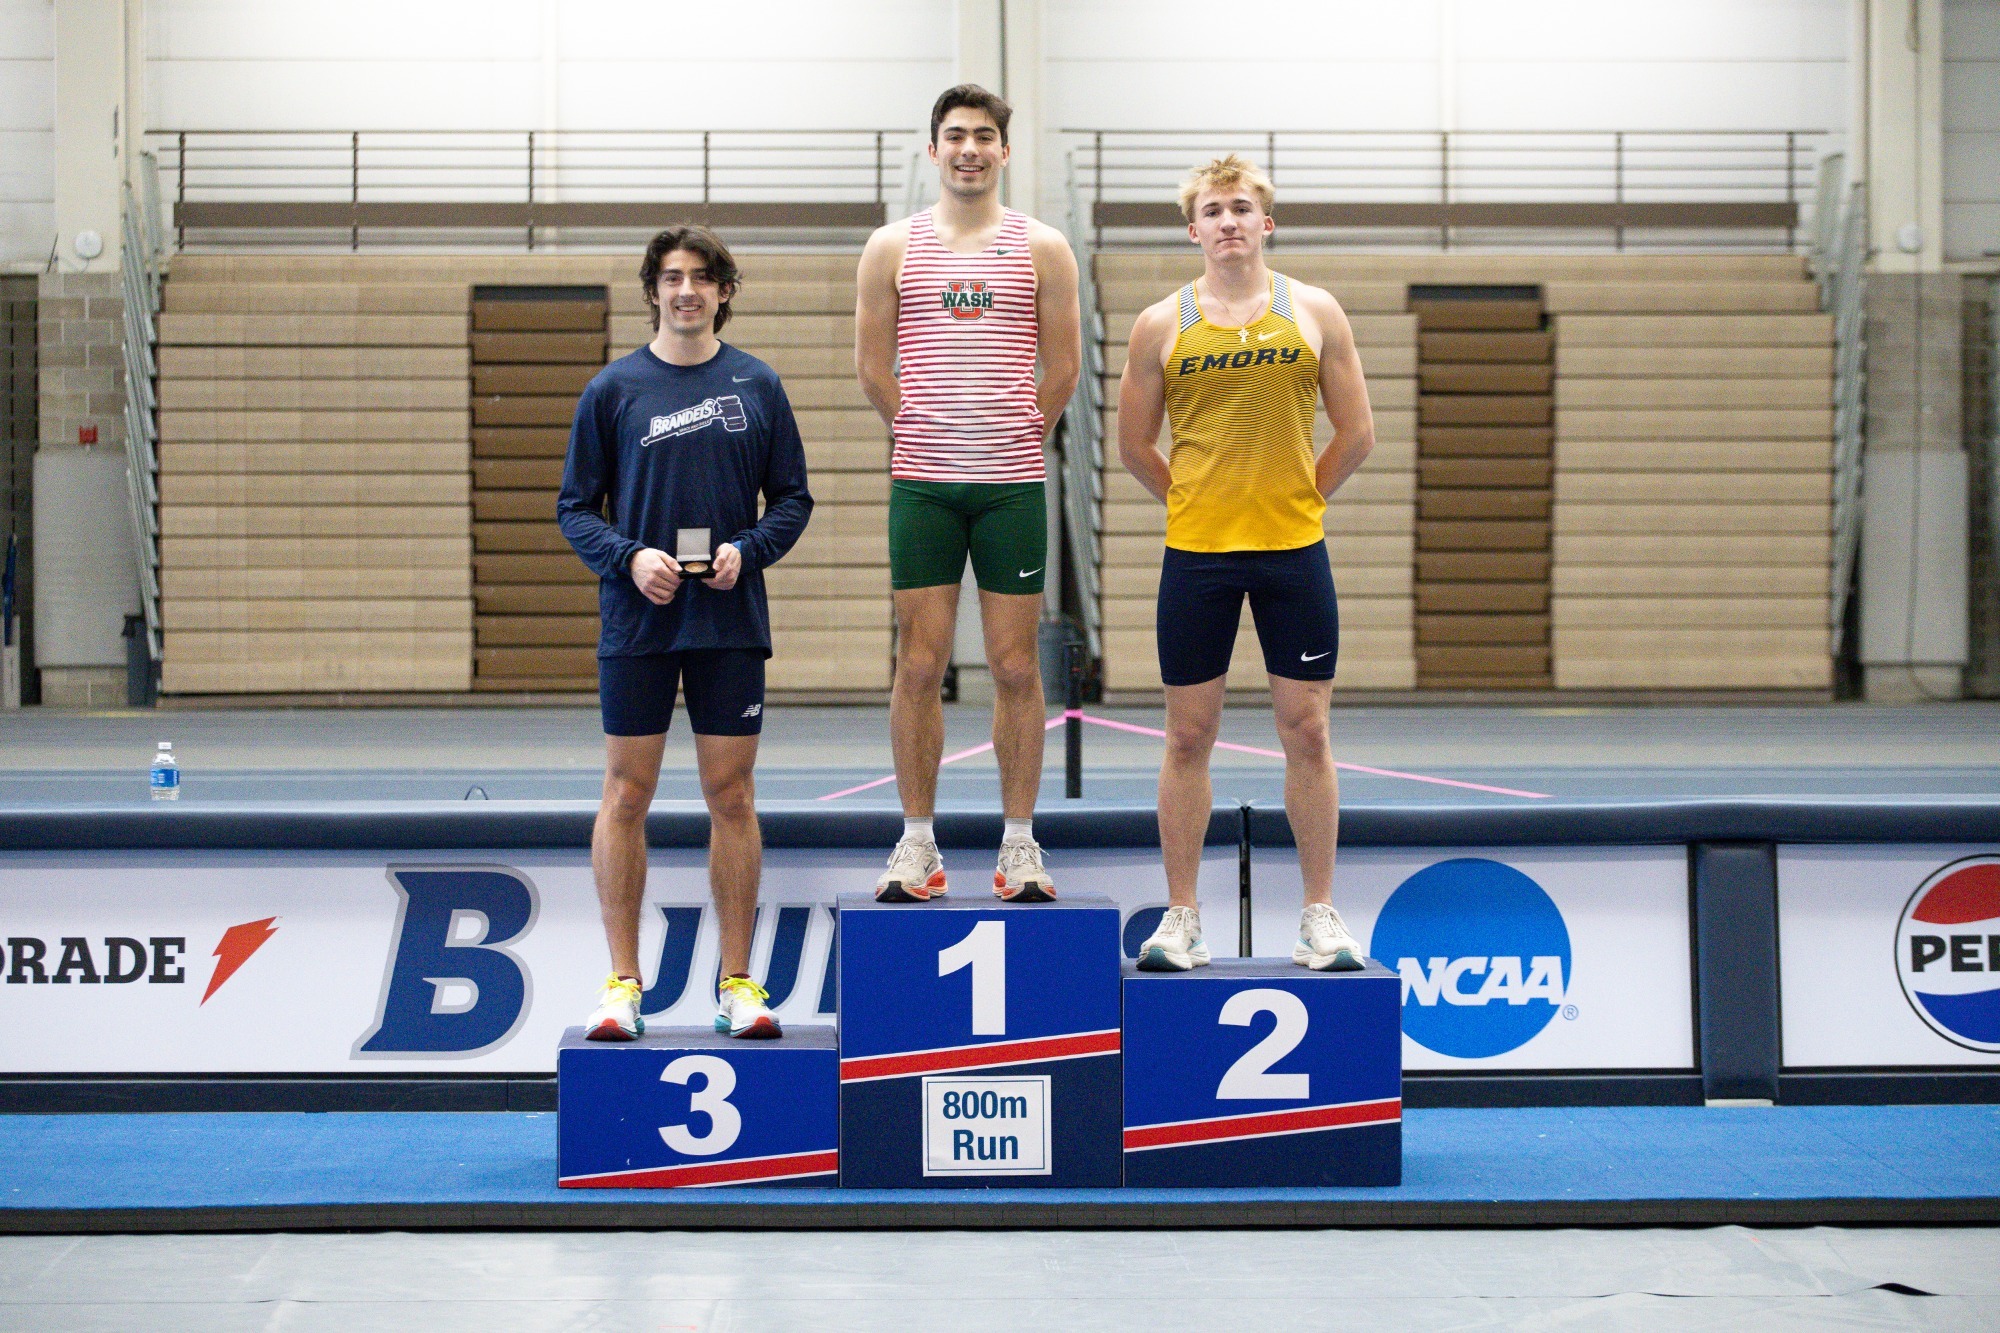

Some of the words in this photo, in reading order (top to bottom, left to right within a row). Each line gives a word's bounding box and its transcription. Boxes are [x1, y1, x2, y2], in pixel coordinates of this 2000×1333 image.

[941, 291, 994, 309] WASH
[1179, 347, 1301, 377] EMORY
[651, 400, 715, 438] BRANDEIS
[0, 936, 186, 984] RADE
[351, 864, 540, 1060] B
[938, 920, 1006, 1036] 1
[1397, 955, 1566, 1007] NCAA
[1215, 987, 1310, 1100] 2
[657, 1054, 742, 1156] 3
[942, 1090, 1028, 1120] 800m
[953, 1129, 1019, 1161] Run
